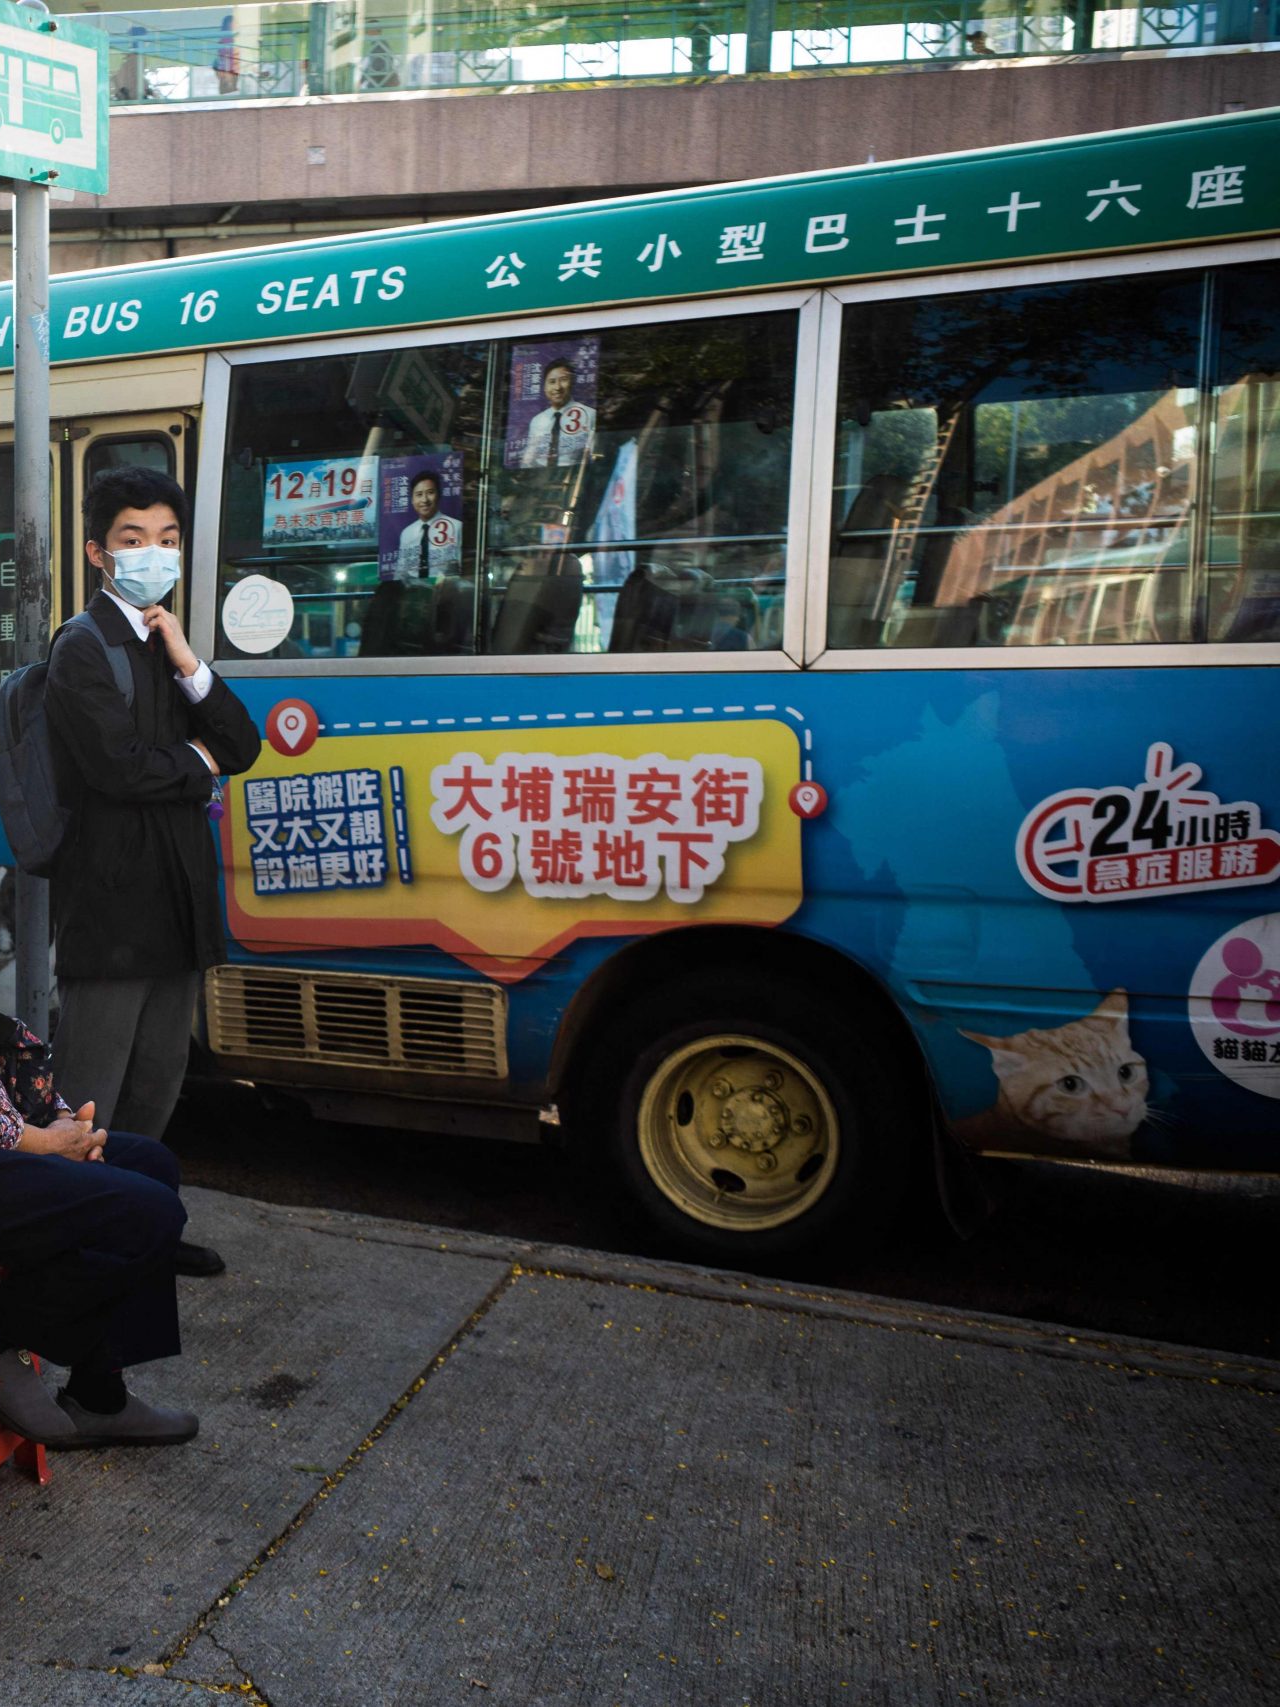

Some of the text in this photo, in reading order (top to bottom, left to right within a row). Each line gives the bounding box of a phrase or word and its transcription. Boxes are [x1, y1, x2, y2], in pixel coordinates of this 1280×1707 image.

[484, 165, 1246, 289] 公共小型巴士十六座
[63, 299, 142, 339] BUS
[179, 291, 219, 324] 16
[257, 265, 408, 315] SEATS
[270, 467, 373, 500] 12月19日
[273, 509, 366, 530] 為未來齊投票
[443, 765, 749, 827] 大埔瑞安街
[1089, 789, 1251, 857] 24小時
[472, 828, 714, 889] 6號地下
[1094, 843, 1259, 891] 急症服務
